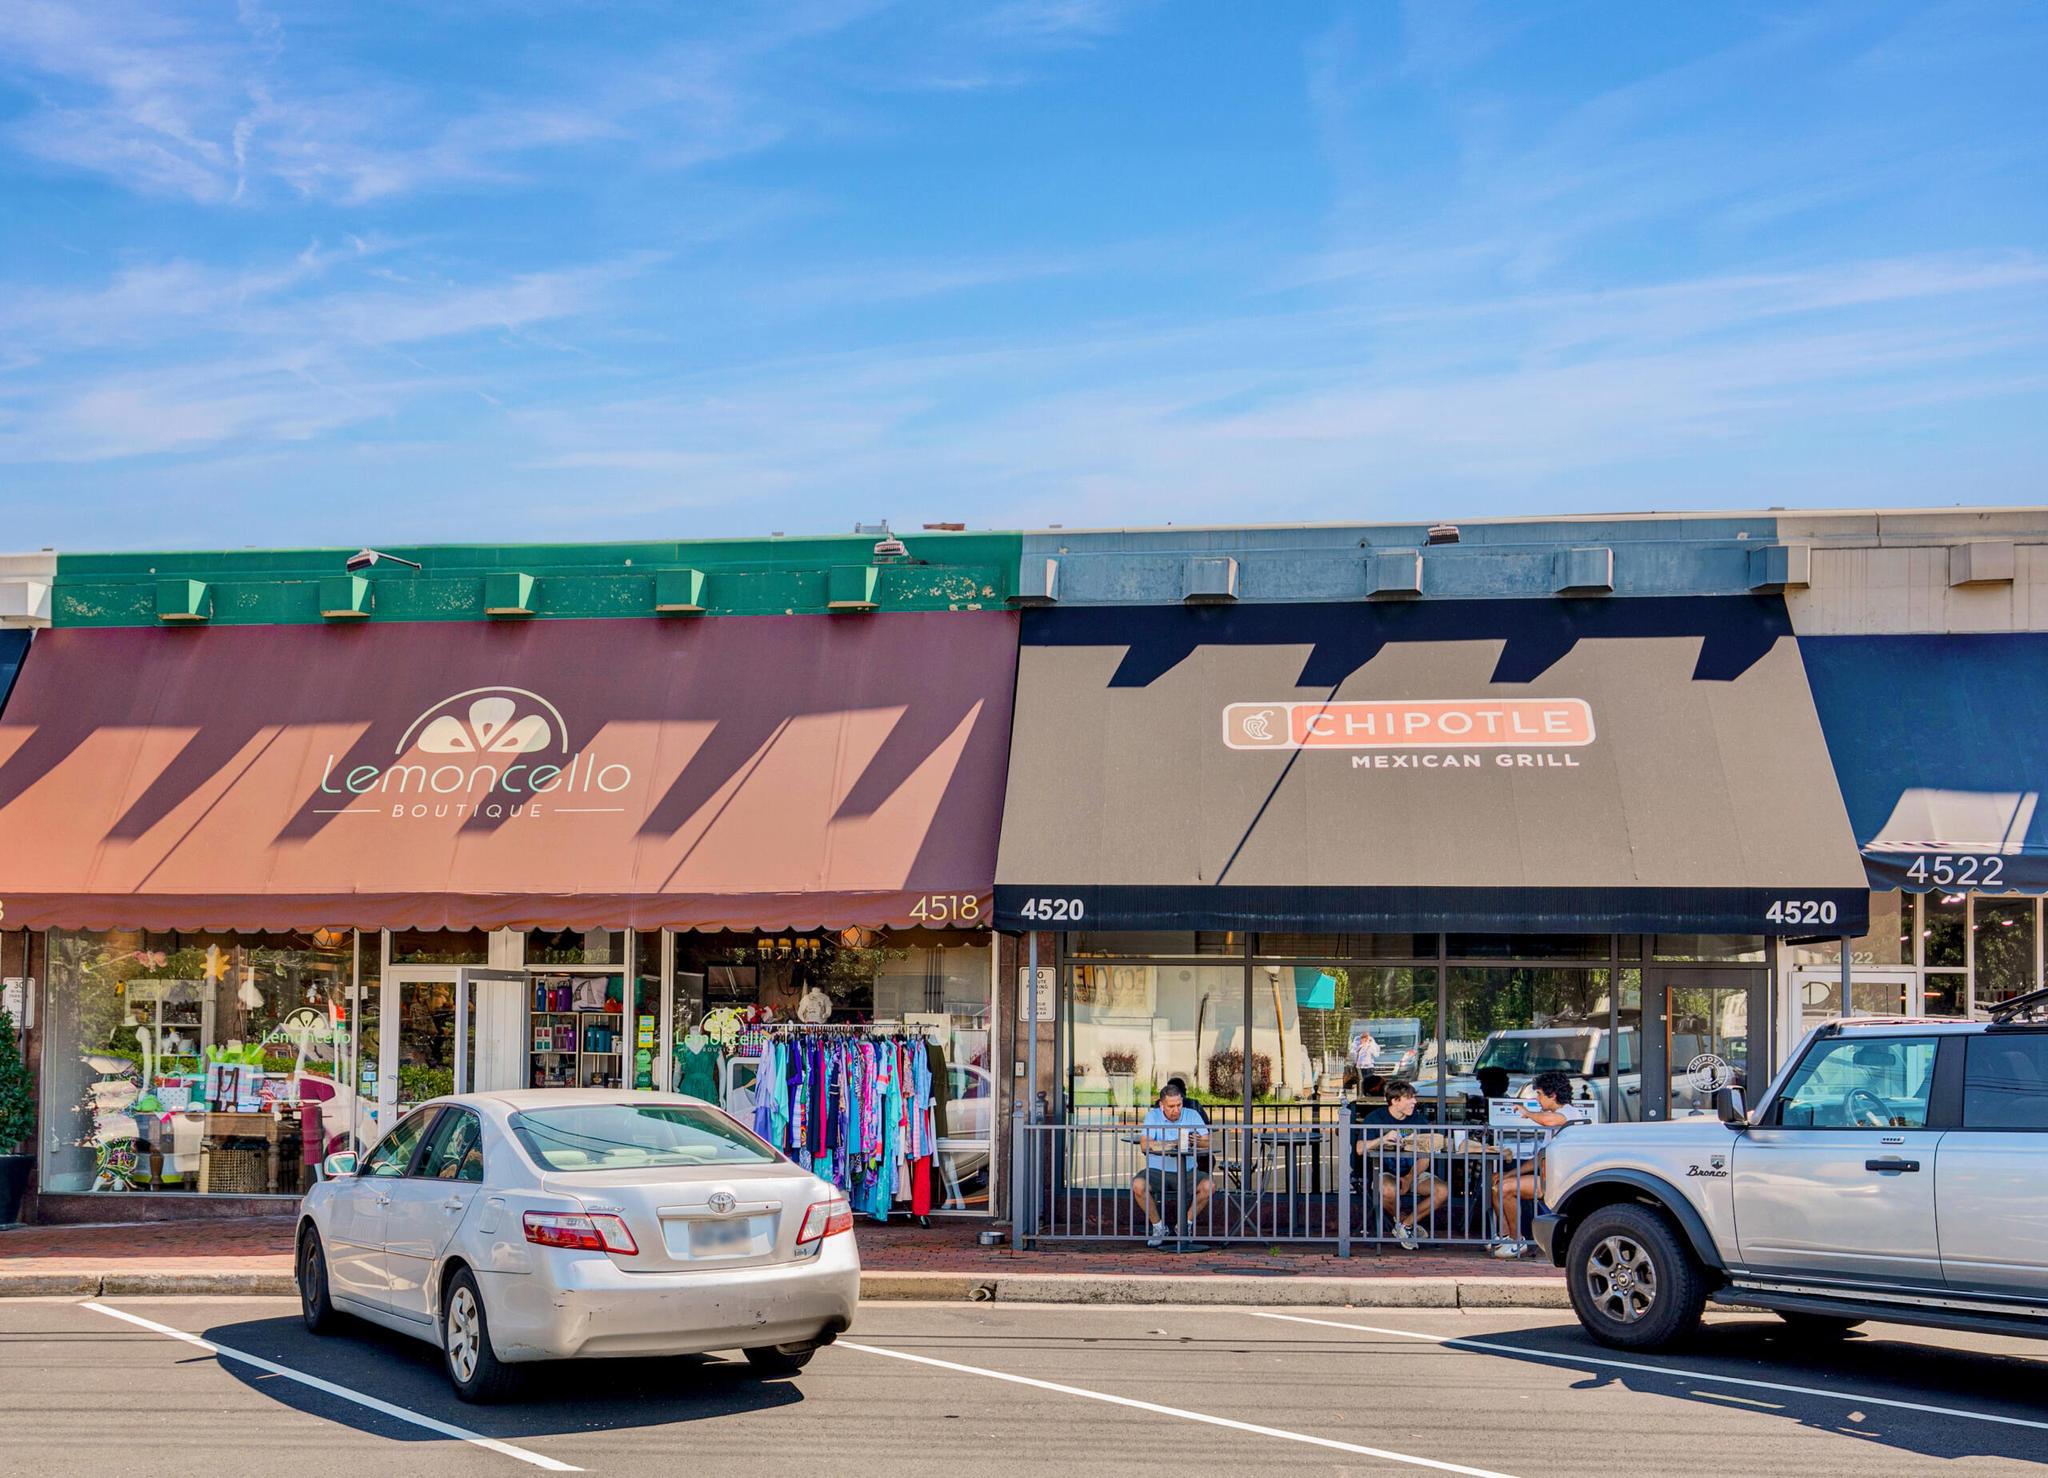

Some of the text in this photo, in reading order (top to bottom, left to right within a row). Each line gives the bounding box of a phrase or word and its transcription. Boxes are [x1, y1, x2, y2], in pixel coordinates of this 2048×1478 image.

[1305, 710, 1573, 737] CHIPOTLE
[1351, 753, 1580, 769] MEXICAN GRILL
[320, 753, 631, 795] Lemoncello
[391, 803, 543, 818] BOUTIQUE
[1906, 855, 2004, 886] 4522
[909, 894, 979, 921] 4518
[1020, 898, 1085, 921] 4520
[1765, 900, 1838, 924] 4520
[1686, 1165, 1728, 1177] Bronco
